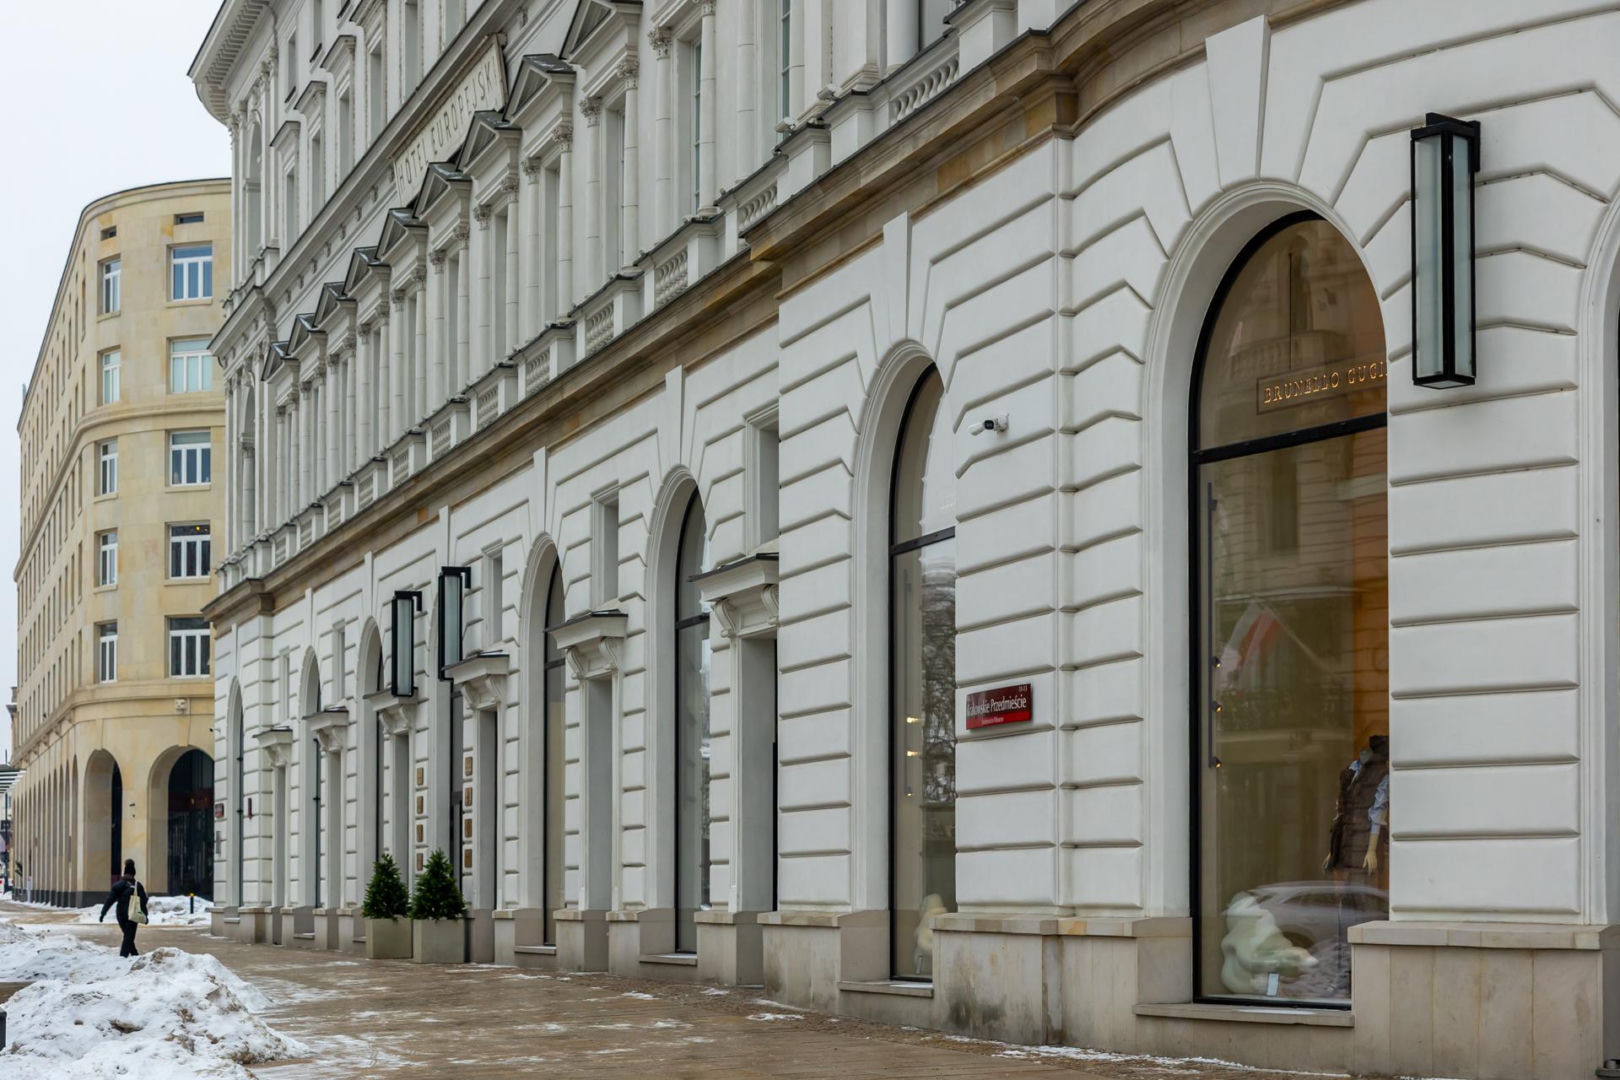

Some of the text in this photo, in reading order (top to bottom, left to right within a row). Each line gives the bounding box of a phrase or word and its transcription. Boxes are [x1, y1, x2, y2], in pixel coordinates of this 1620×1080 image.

[397, 56, 498, 189] HOTEL EUROPEJSKI
[1263, 361, 1388, 404] BRUNELLO CUCI
[990, 694, 1027, 713] Przedmieście
